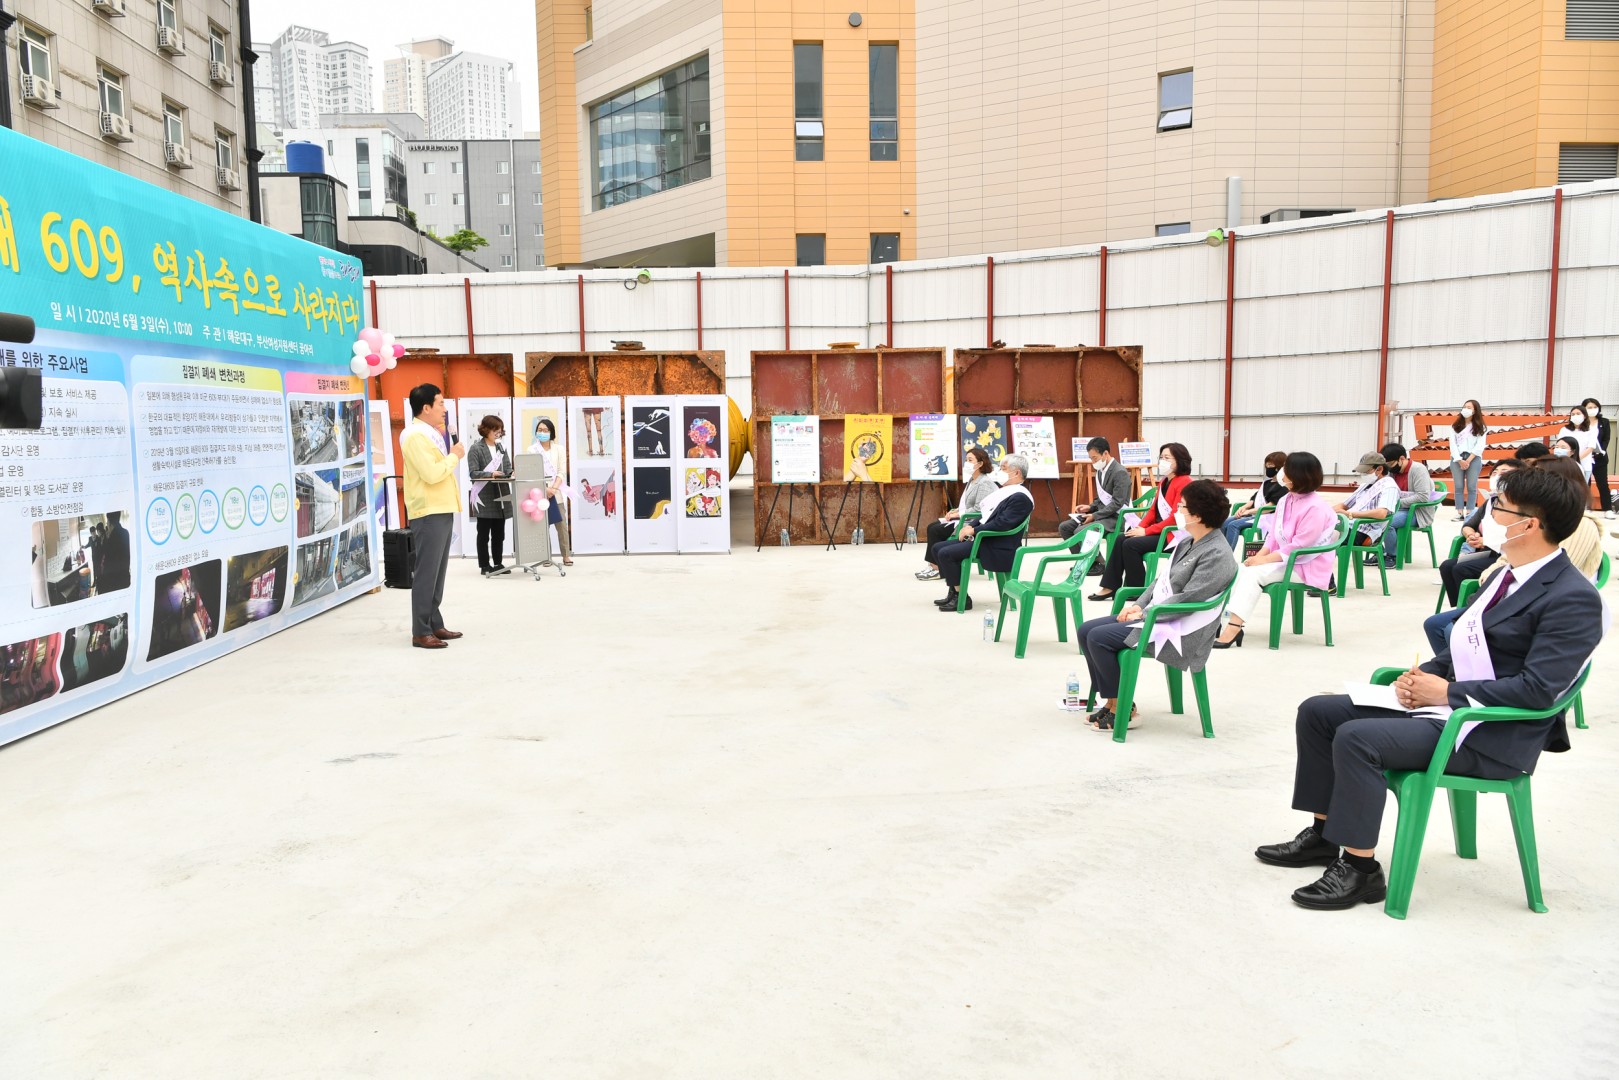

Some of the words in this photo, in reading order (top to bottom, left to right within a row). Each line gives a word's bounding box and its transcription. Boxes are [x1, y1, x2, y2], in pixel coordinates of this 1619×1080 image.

[40, 211, 141, 293] 609,
[153, 241, 287, 316] 역사속으로
[50, 302, 62, 320] 일
[66, 304, 76, 322] 시
[85, 308, 120, 328] 2020년
[123, 313, 138, 331] 6월
[141, 316, 172, 335] 3일(수),
[173, 321, 193, 336] 10:00
[202, 325, 211, 339] 주
[213, 327, 222, 341] 관
[22, 351, 43, 370] 위한
[48, 354, 89, 374] 주요사업
[182, 365, 200, 380] 집결지
[220, 368, 246, 384] 변천과정
[49, 388, 64, 398] 보호
[66, 388, 83, 399] 서비스
[84, 389, 96, 400] 제공
[48, 408, 62, 418] 지속
[65, 408, 78, 418] 실시
[26, 444, 40, 456] 운영
[8, 465, 24, 477] 운영
[33, 484, 45, 496] 작은
[72, 482, 84, 492] 운영
[30, 506, 44, 518] 합동
[46, 502, 84, 515] 소방안전점검
